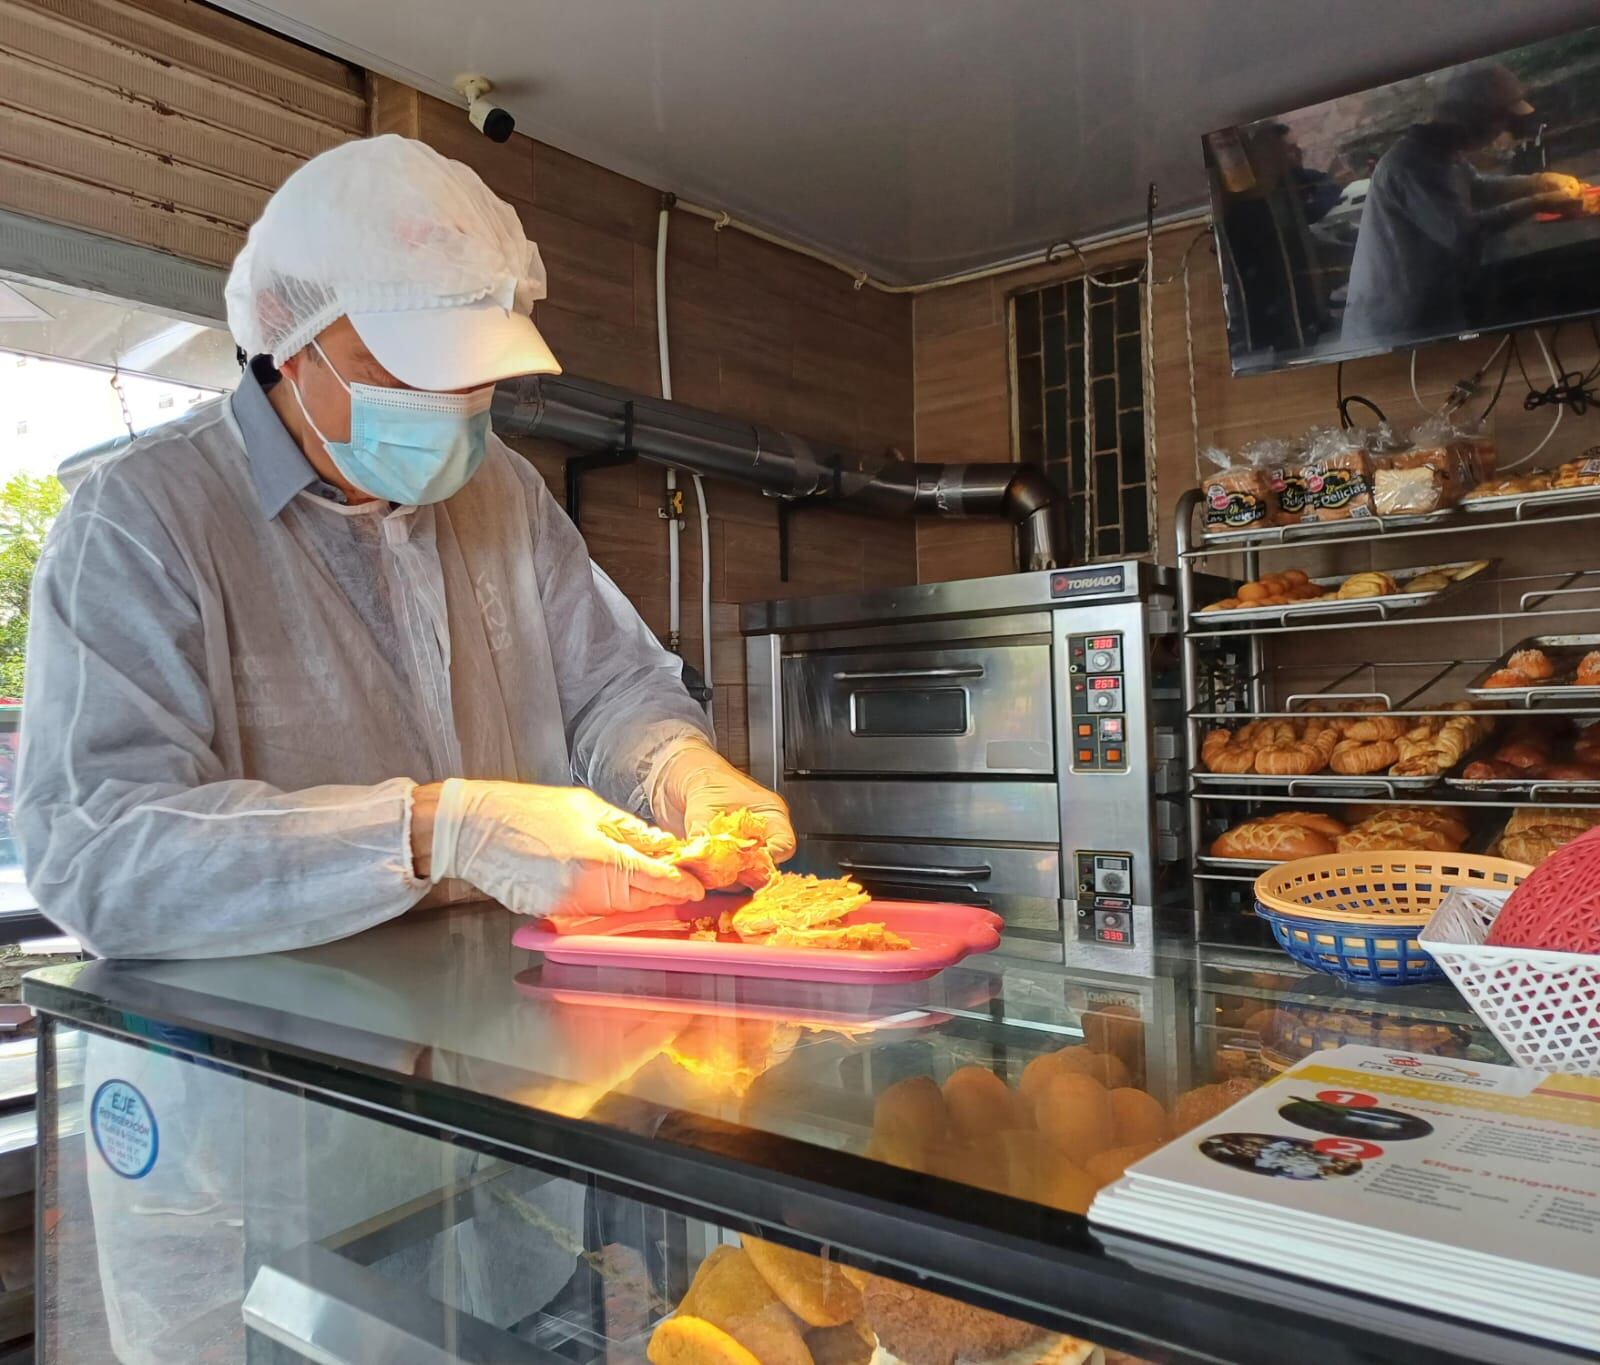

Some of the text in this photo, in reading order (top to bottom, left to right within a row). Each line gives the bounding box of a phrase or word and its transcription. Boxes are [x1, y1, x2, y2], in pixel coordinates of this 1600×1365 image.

[1321, 483, 1367, 505] Delicias
[1068, 575, 1121, 590] TORNADO
[1402, 1067, 1498, 1087] Delicias
[1336, 1093, 1356, 1104] 1
[1326, 1141, 1365, 1157] 2
[1422, 1158, 1473, 1174] Elige
